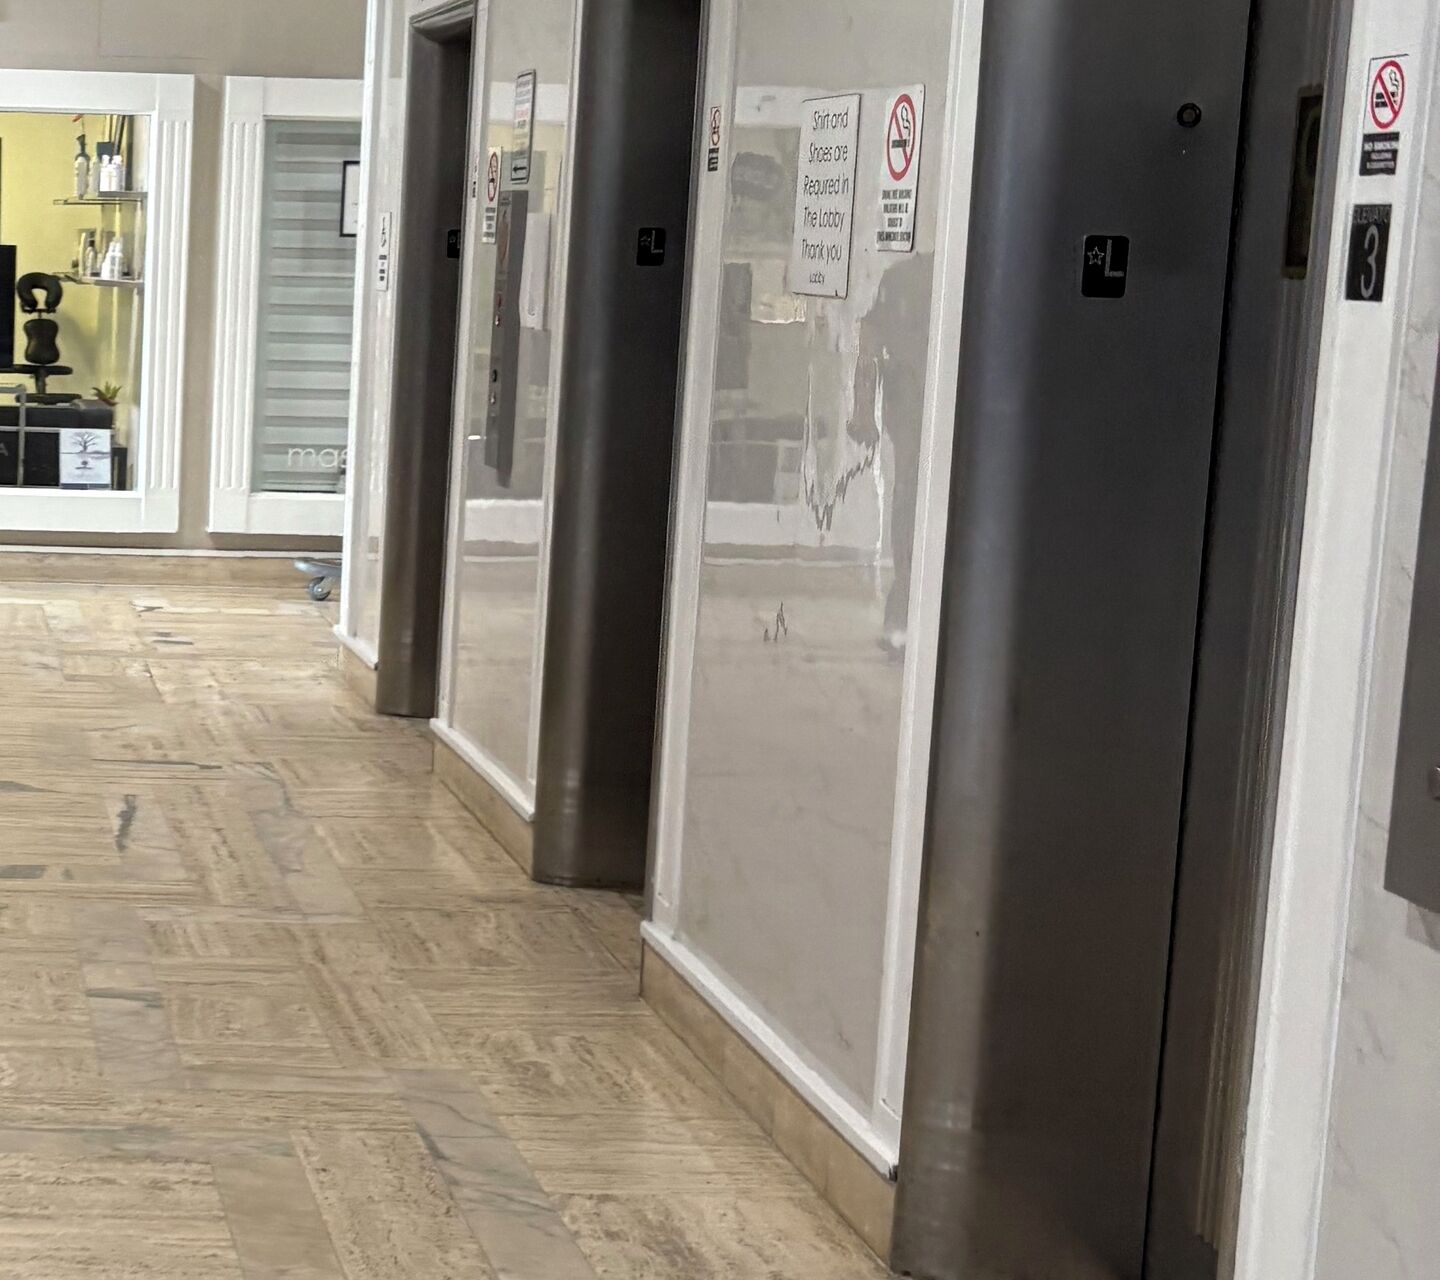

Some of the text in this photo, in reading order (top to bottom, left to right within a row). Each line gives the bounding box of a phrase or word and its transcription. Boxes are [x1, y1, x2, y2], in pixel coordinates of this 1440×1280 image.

[812, 107, 849, 131] Shirt and
[809, 142, 848, 163] Shoes are
[803, 173, 849, 199] Required in
[803, 207, 845, 232] The Lobby
[801, 239, 842, 264] Thank you
[1104, 239, 1124, 277] L
[1361, 224, 1379, 299] 3
